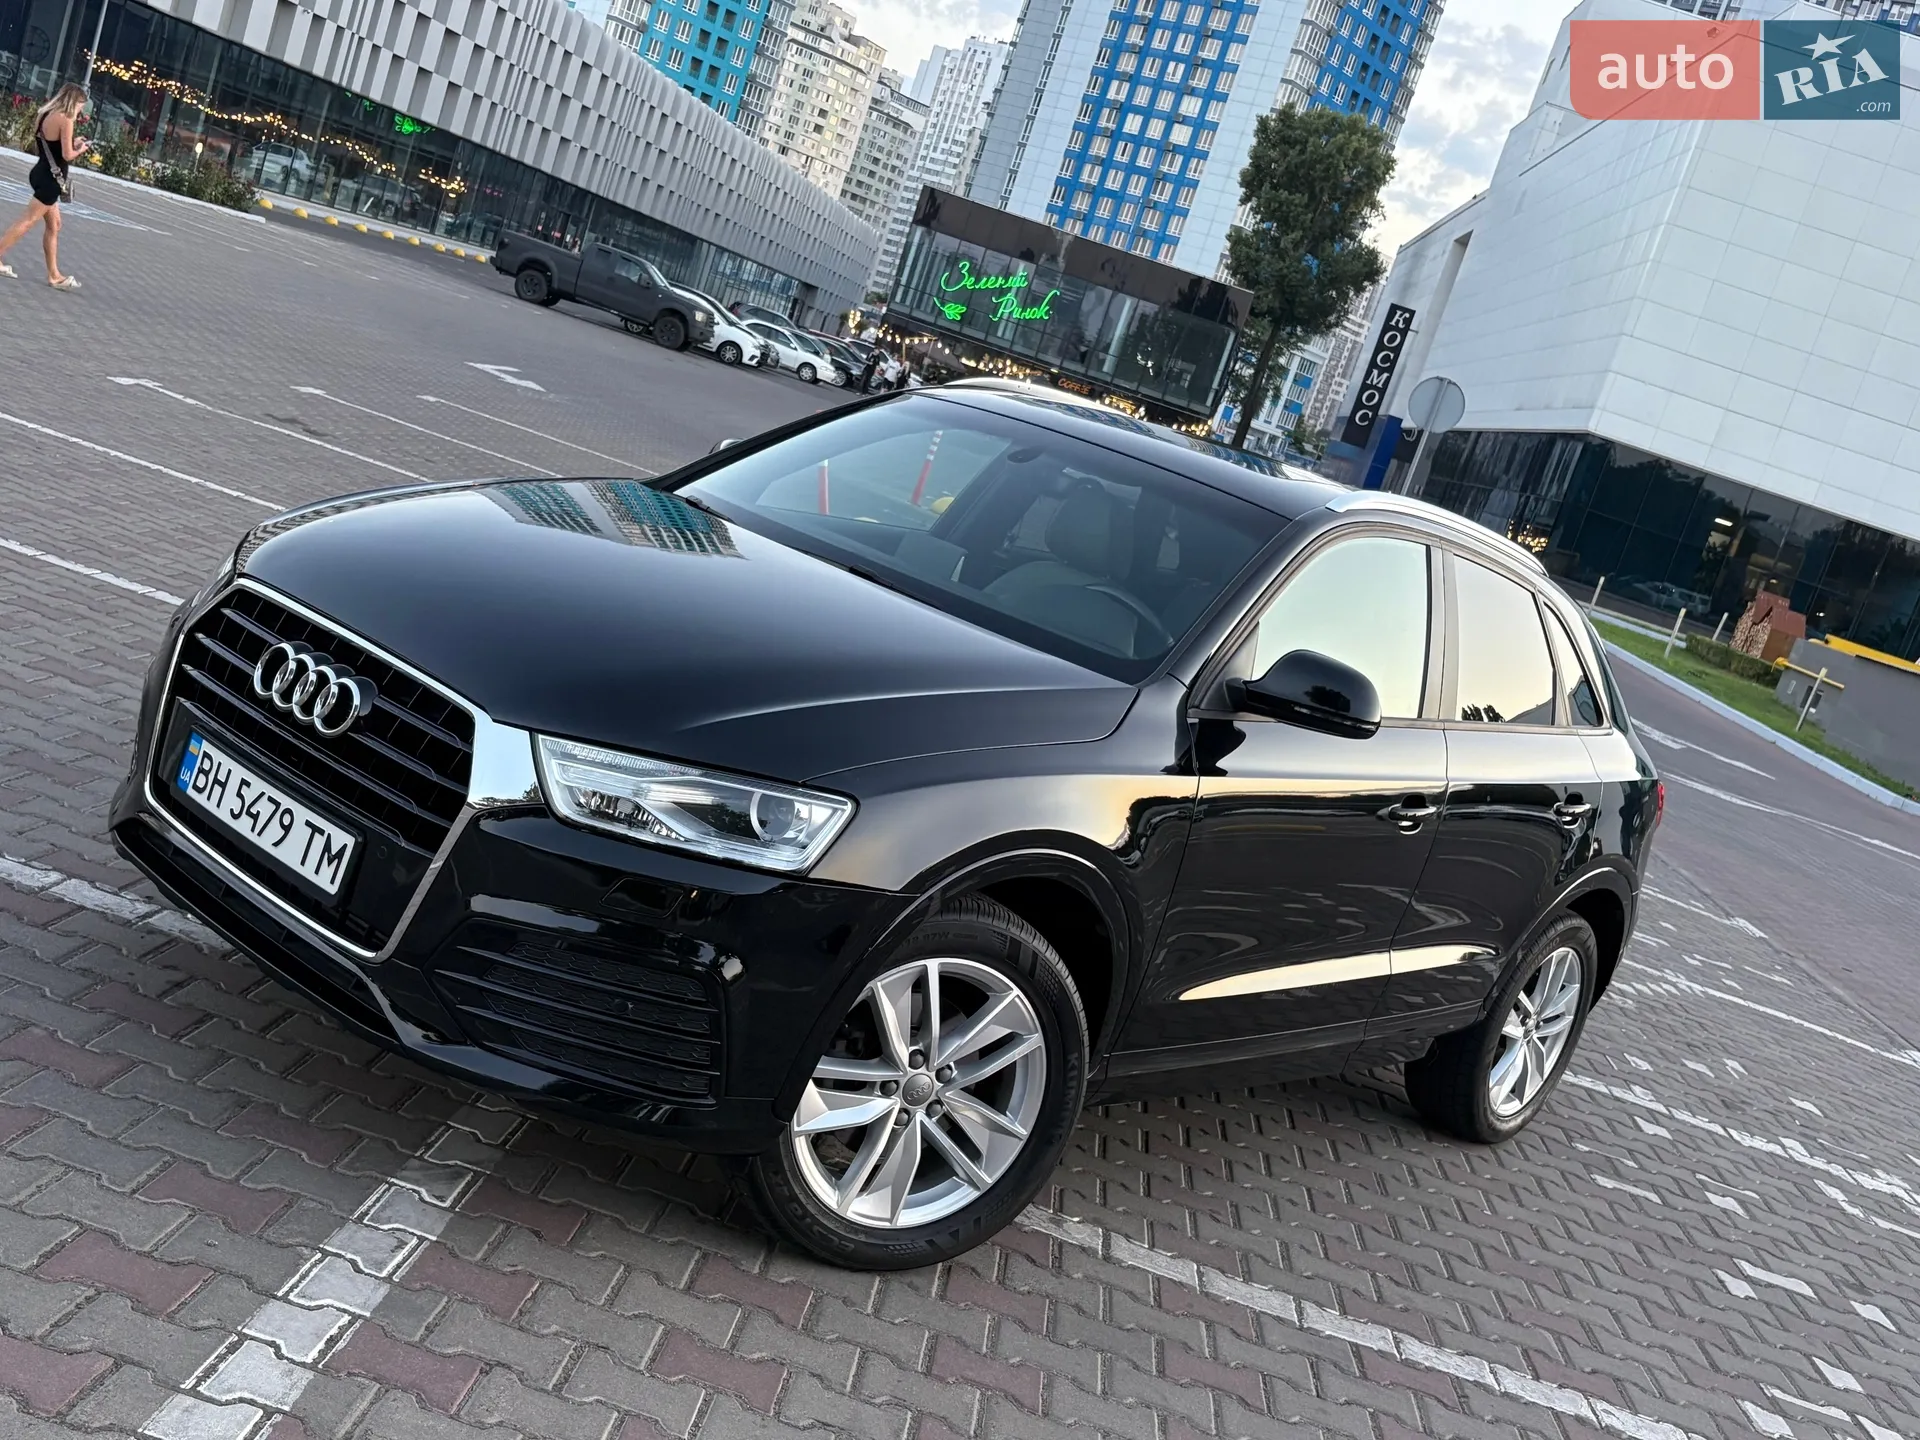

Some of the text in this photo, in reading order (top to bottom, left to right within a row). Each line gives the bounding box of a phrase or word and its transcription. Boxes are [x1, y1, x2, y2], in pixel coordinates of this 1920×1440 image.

[940, 261, 1029, 292] Зелений
[989, 289, 1060, 322] Ринок
[1354, 309, 1411, 427] КОСМОС
[1057, 377, 1092, 395] COFFEE
[180, 768, 190, 784] UA
[192, 750, 348, 886] BH 5479 TM
